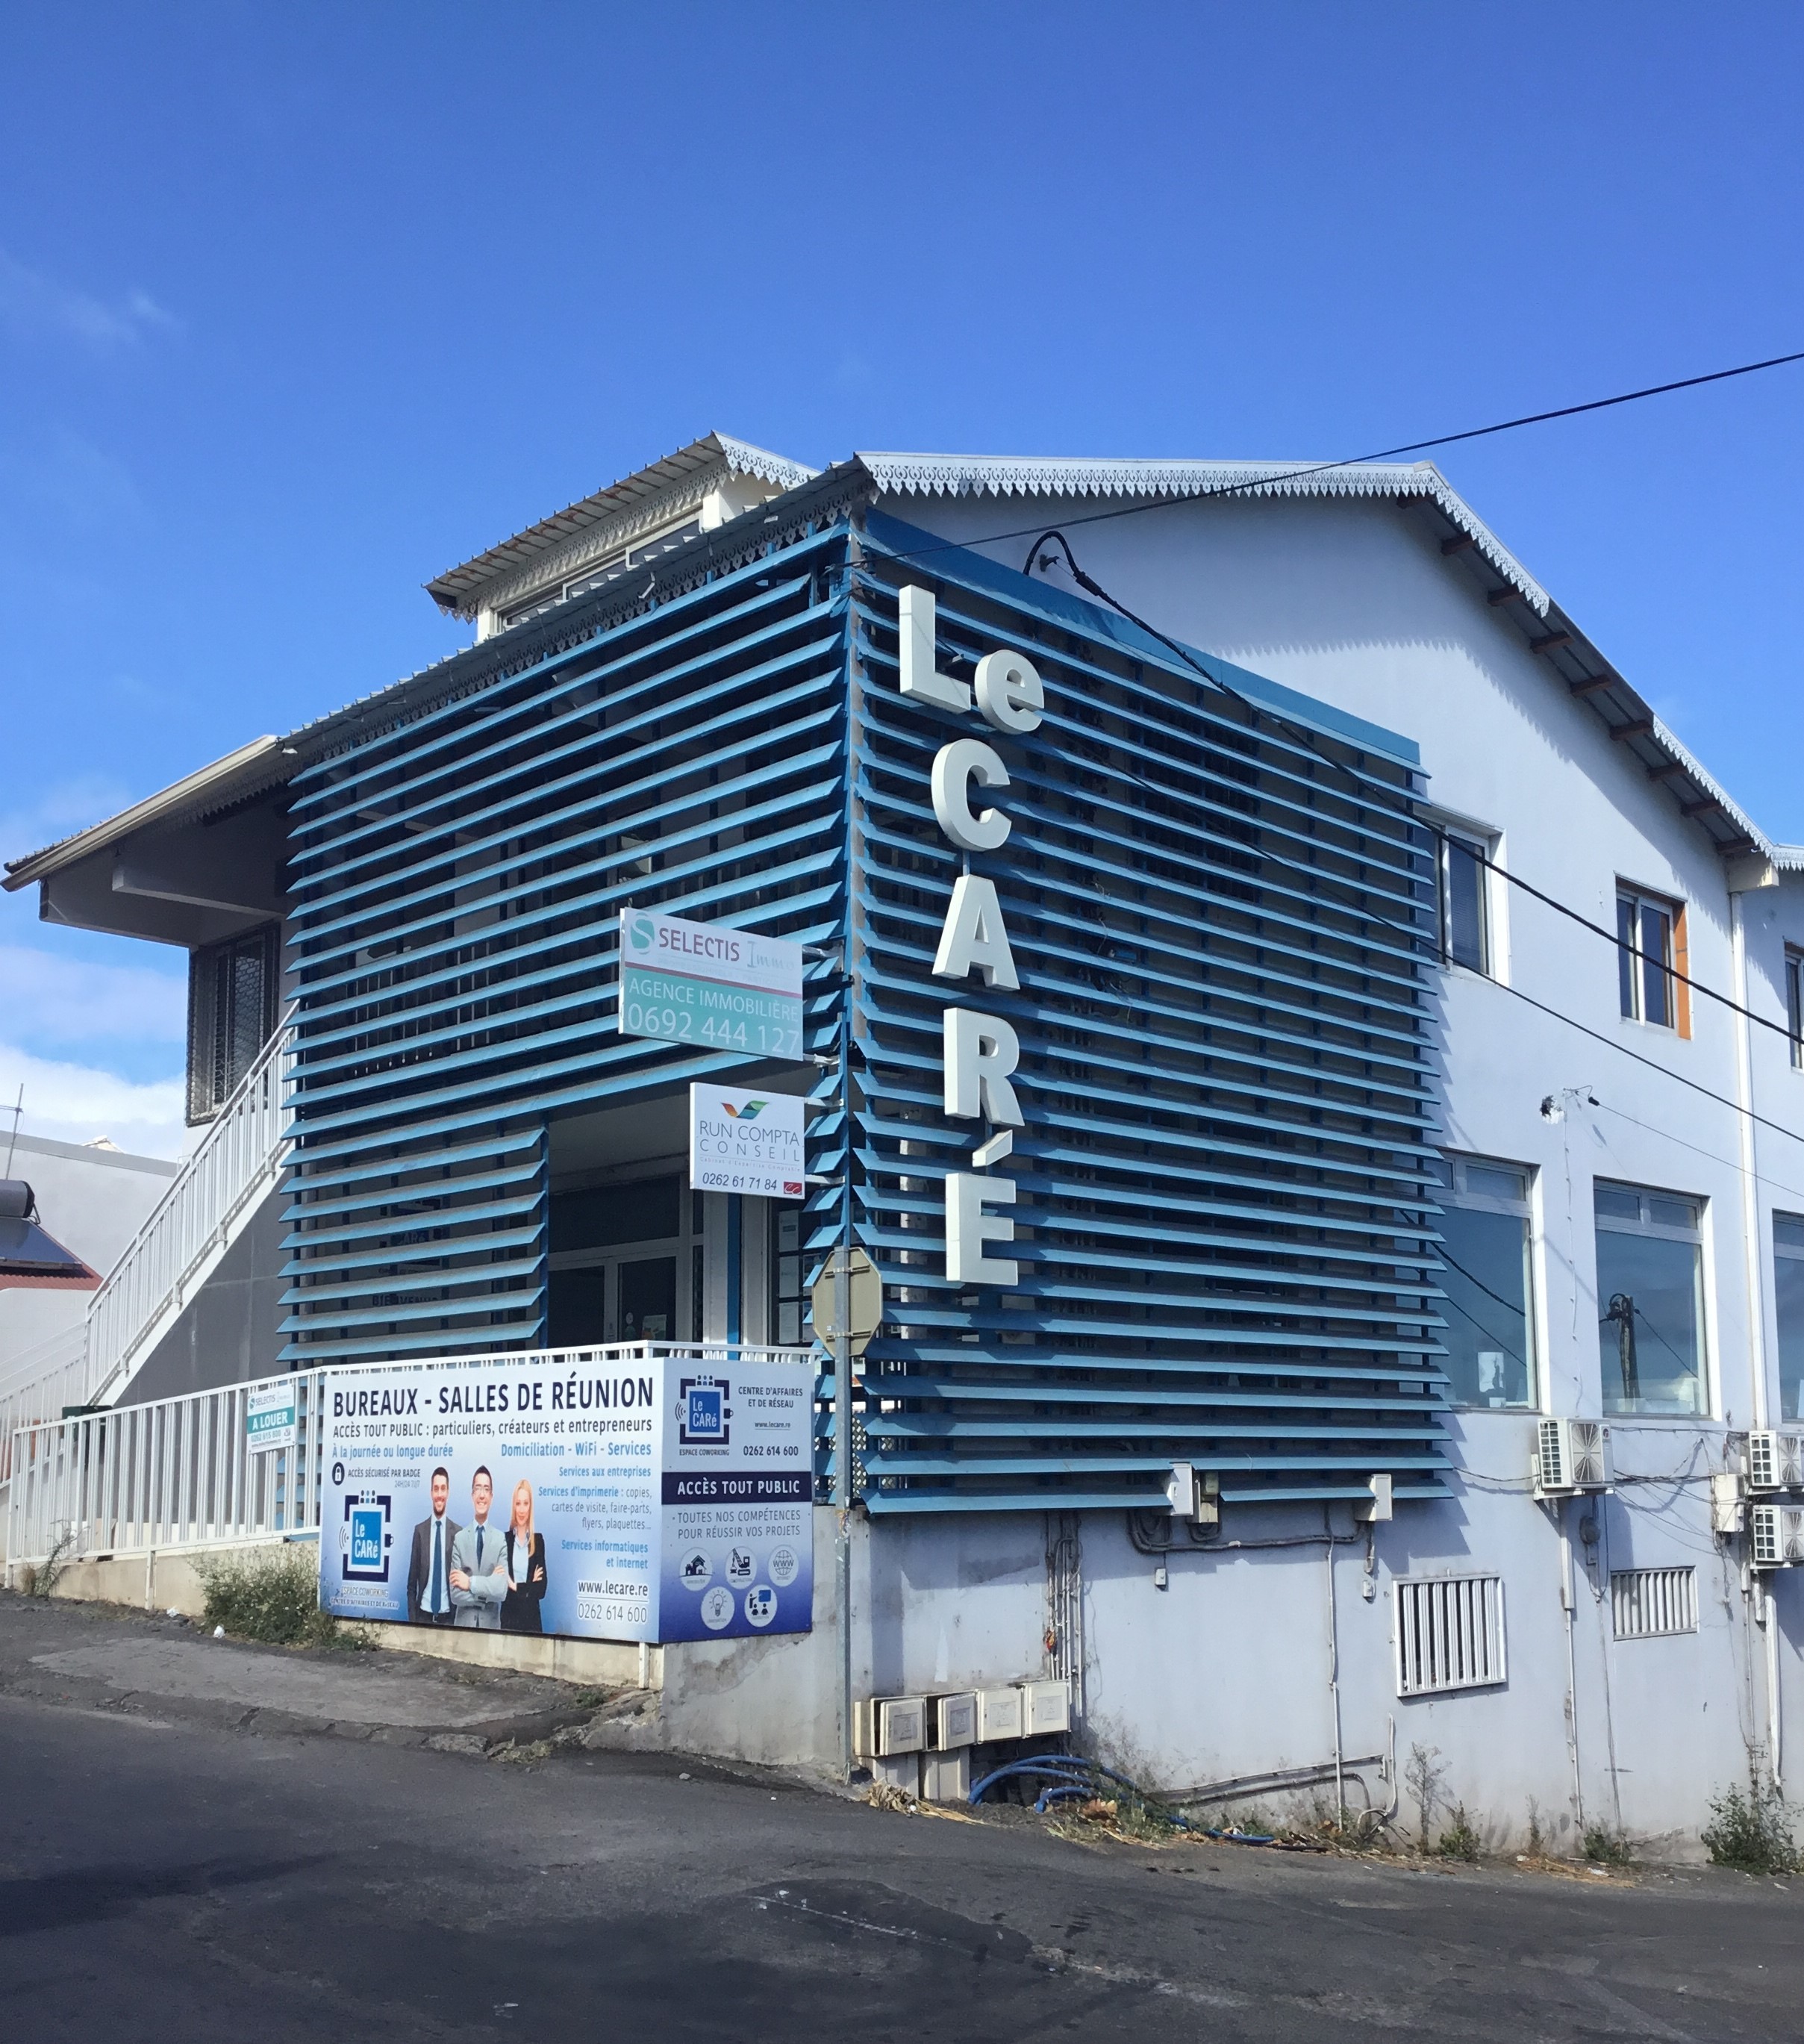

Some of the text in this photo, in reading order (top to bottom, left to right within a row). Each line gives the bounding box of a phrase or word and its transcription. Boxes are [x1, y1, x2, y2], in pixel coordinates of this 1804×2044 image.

[659, 926, 740, 962] SELECTIS
[899, 585, 1044, 1286] Le CARÉ
[629, 977, 695, 1005] AGENCE
[699, 989, 799, 1023] IMMOBILIÈRE
[628, 1003, 799, 1055] 0692 444 127
[699, 1121, 799, 1146] RUN COMPTA
[699, 1139, 800, 1162] CONSEIL
[702, 1172, 777, 1191] 0262 61 71 84
[334, 1388, 418, 1418] BUREAUX
[438, 1384, 509, 1414] SALLES
[517, 1383, 543, 1411] DE
[552, 1371, 653, 1409] RÉUNION
[738, 1386, 803, 1397] CENTRE D'AFFAIRES
[255, 1395, 275, 1406] SELECTIS
[693, 1398, 702, 1412] Le
[748, 1397, 793, 1408] ET DE RÉSEAU
[252, 1411, 288, 1430] A LOUER
[333, 1421, 361, 1438] ACCÈS
[364, 1424, 387, 1437] TOUT
[390, 1423, 423, 1436] PUBLIC
[433, 1420, 495, 1439] particuliers,
[499, 1418, 549, 1434] créateurs
[554, 1419, 564, 1433] et
[569, 1418, 652, 1436] entrepreneurs
[693, 1413, 717, 1427] CARé
[332, 1444, 453, 1461] À la journée ou longue durée
[501, 1442, 564, 1456] Domiciliation
[575, 1441, 597, 1456] WiFi
[608, 1440, 652, 1456] Services
[743, 1445, 799, 1456] 0262 614 600
[348, 1466, 420, 1478] ACCÈS SÉCURISÉ PAR BADGE
[559, 1465, 652, 1479] Services aux entreprises
[538, 1486, 569, 1497] Services
[570, 1486, 619, 1499] d'imprimerie
[625, 1486, 652, 1500] copies,
[677, 1477, 800, 1495] ACCÈS TOUT PUBLIC
[552, 1501, 652, 1515] cartes de visite, faire-parts,
[678, 1507, 801, 1524] TOUTES NOS COMPÉTENCES
[355, 1518, 365, 1538] Le
[582, 1517, 604, 1530] flyers,
[678, 1525, 801, 1539] POUR RÉUSSIR VOS PROJETS
[355, 1539, 378, 1559] CARé
[561, 1539, 649, 1554] Services informatiques
[606, 1557, 649, 1569] et internet
[773, 1560, 794, 1568] WWW
[578, 1580, 648, 1597] www.lecare.re
[578, 1603, 647, 1623] 0262 614 600
